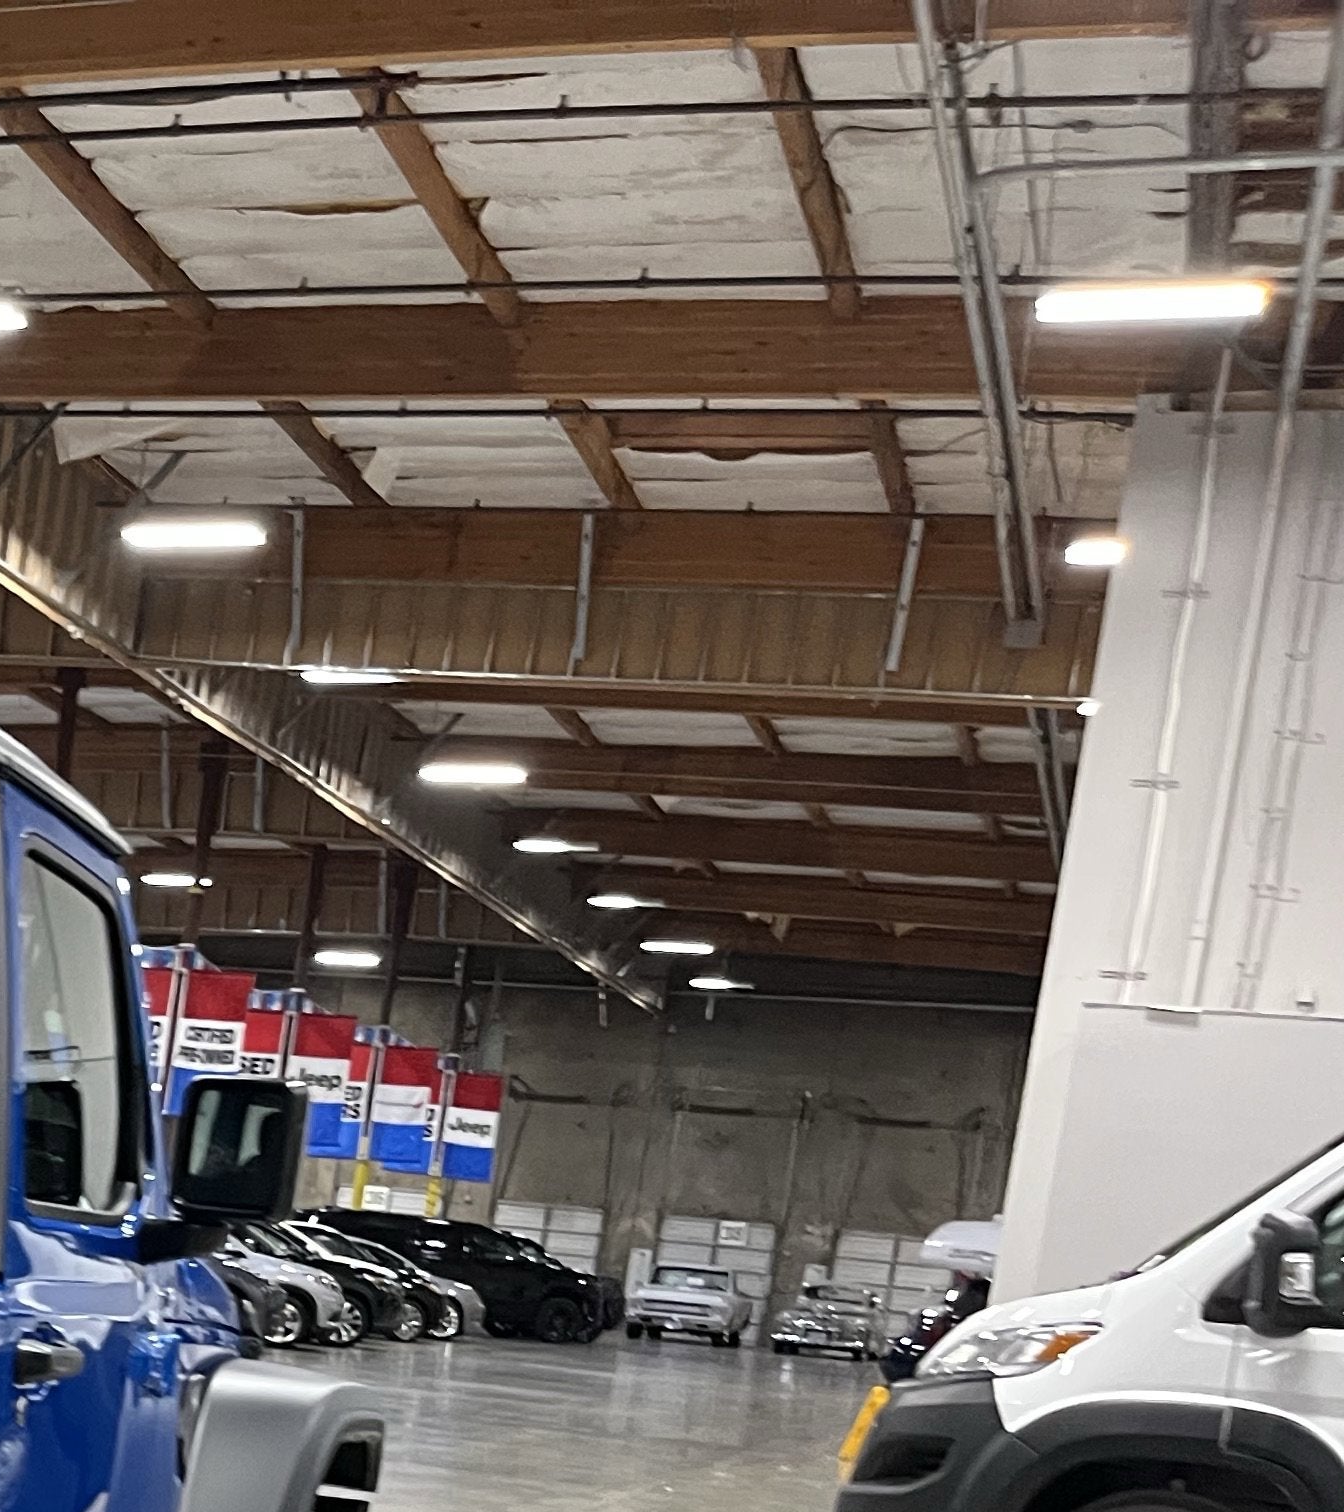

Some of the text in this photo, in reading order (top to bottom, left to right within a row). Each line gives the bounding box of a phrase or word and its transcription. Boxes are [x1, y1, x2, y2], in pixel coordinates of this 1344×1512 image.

[240, 1056, 275, 1075] SED
[288, 1068, 342, 1091] Jeep
[448, 1117, 491, 1138] Jeep
